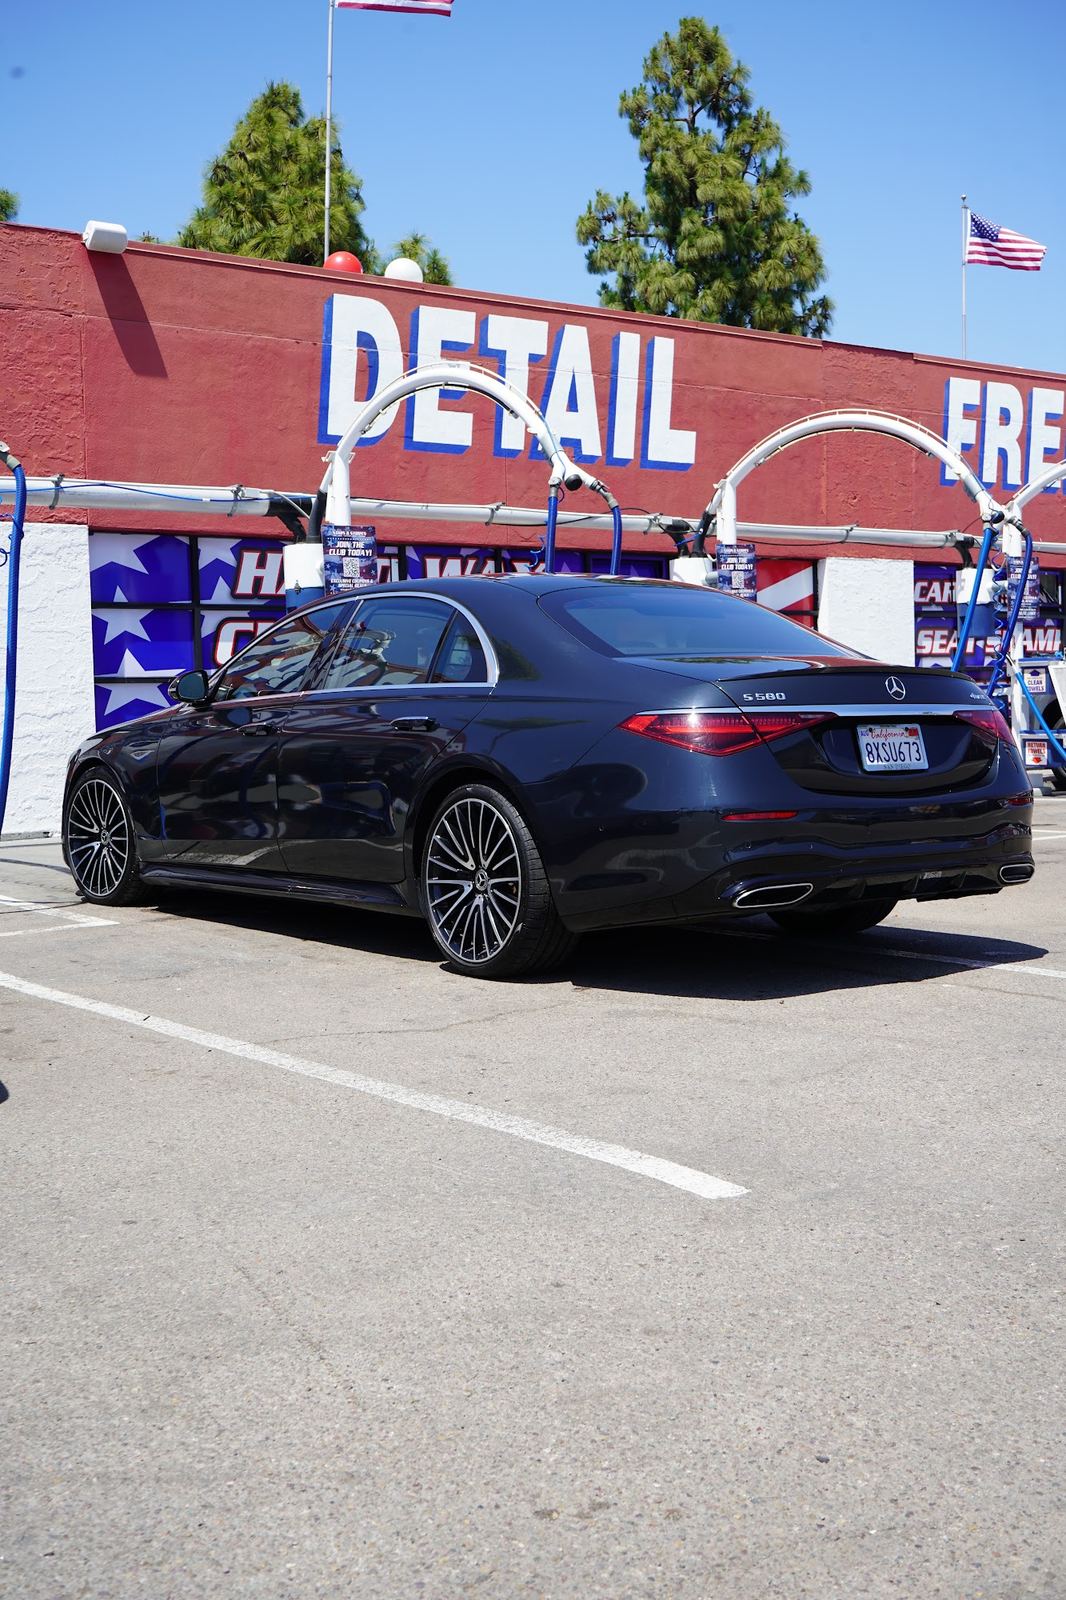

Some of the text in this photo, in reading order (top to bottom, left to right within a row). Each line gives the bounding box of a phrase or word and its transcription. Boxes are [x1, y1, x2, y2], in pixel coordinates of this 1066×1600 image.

[318, 293, 698, 471] DETAIL
[940, 376, 1066, 491] FRE
[329, 548, 346, 556] CLUB
[743, 692, 786, 701] S 580
[865, 741, 922, 763] 8XSU673
